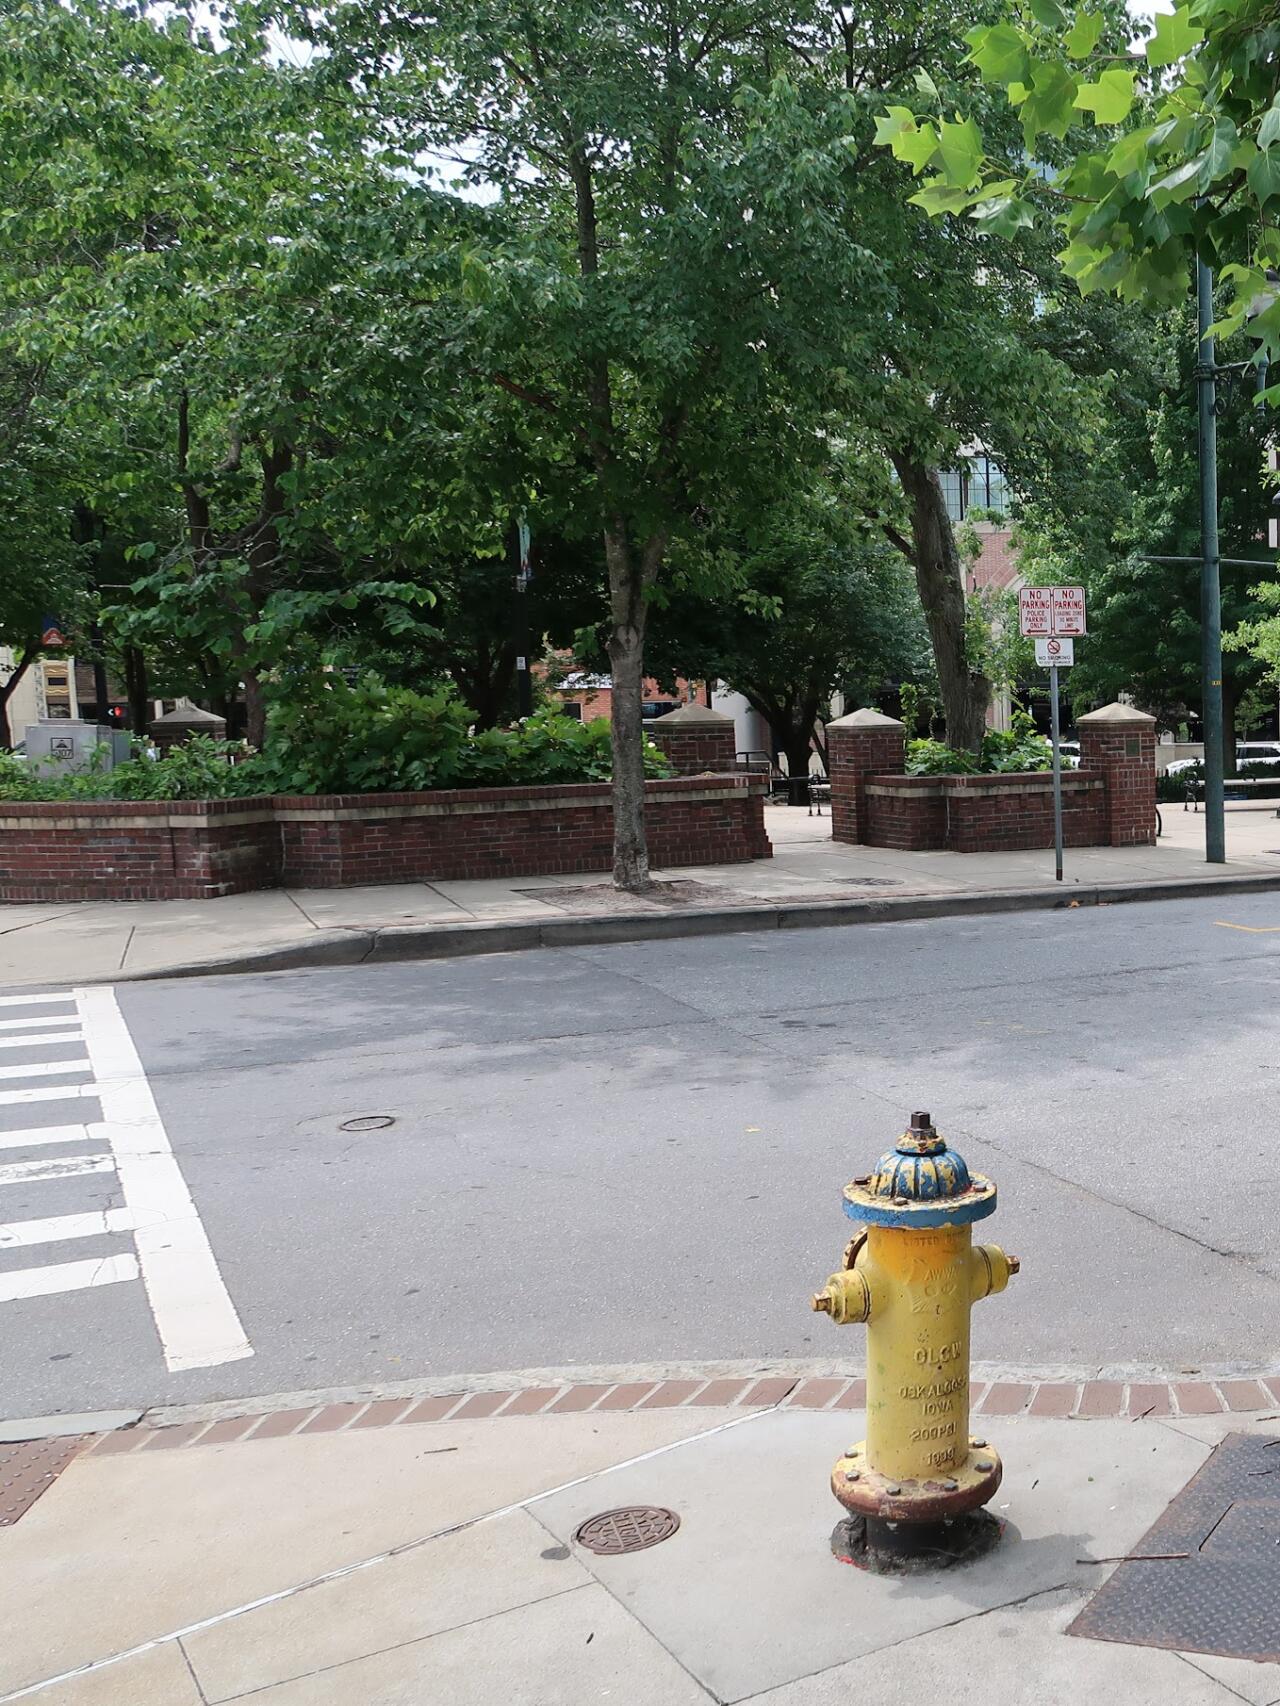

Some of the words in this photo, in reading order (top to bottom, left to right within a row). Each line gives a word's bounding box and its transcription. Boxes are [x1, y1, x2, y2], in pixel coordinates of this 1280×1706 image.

[1029, 590, 1042, 600] NO
[1062, 590, 1074, 600] NO
[1022, 600, 1050, 610] PARKING
[1055, 600, 1083, 610] PARKING
[922, 1399, 954, 1416] IOWA
